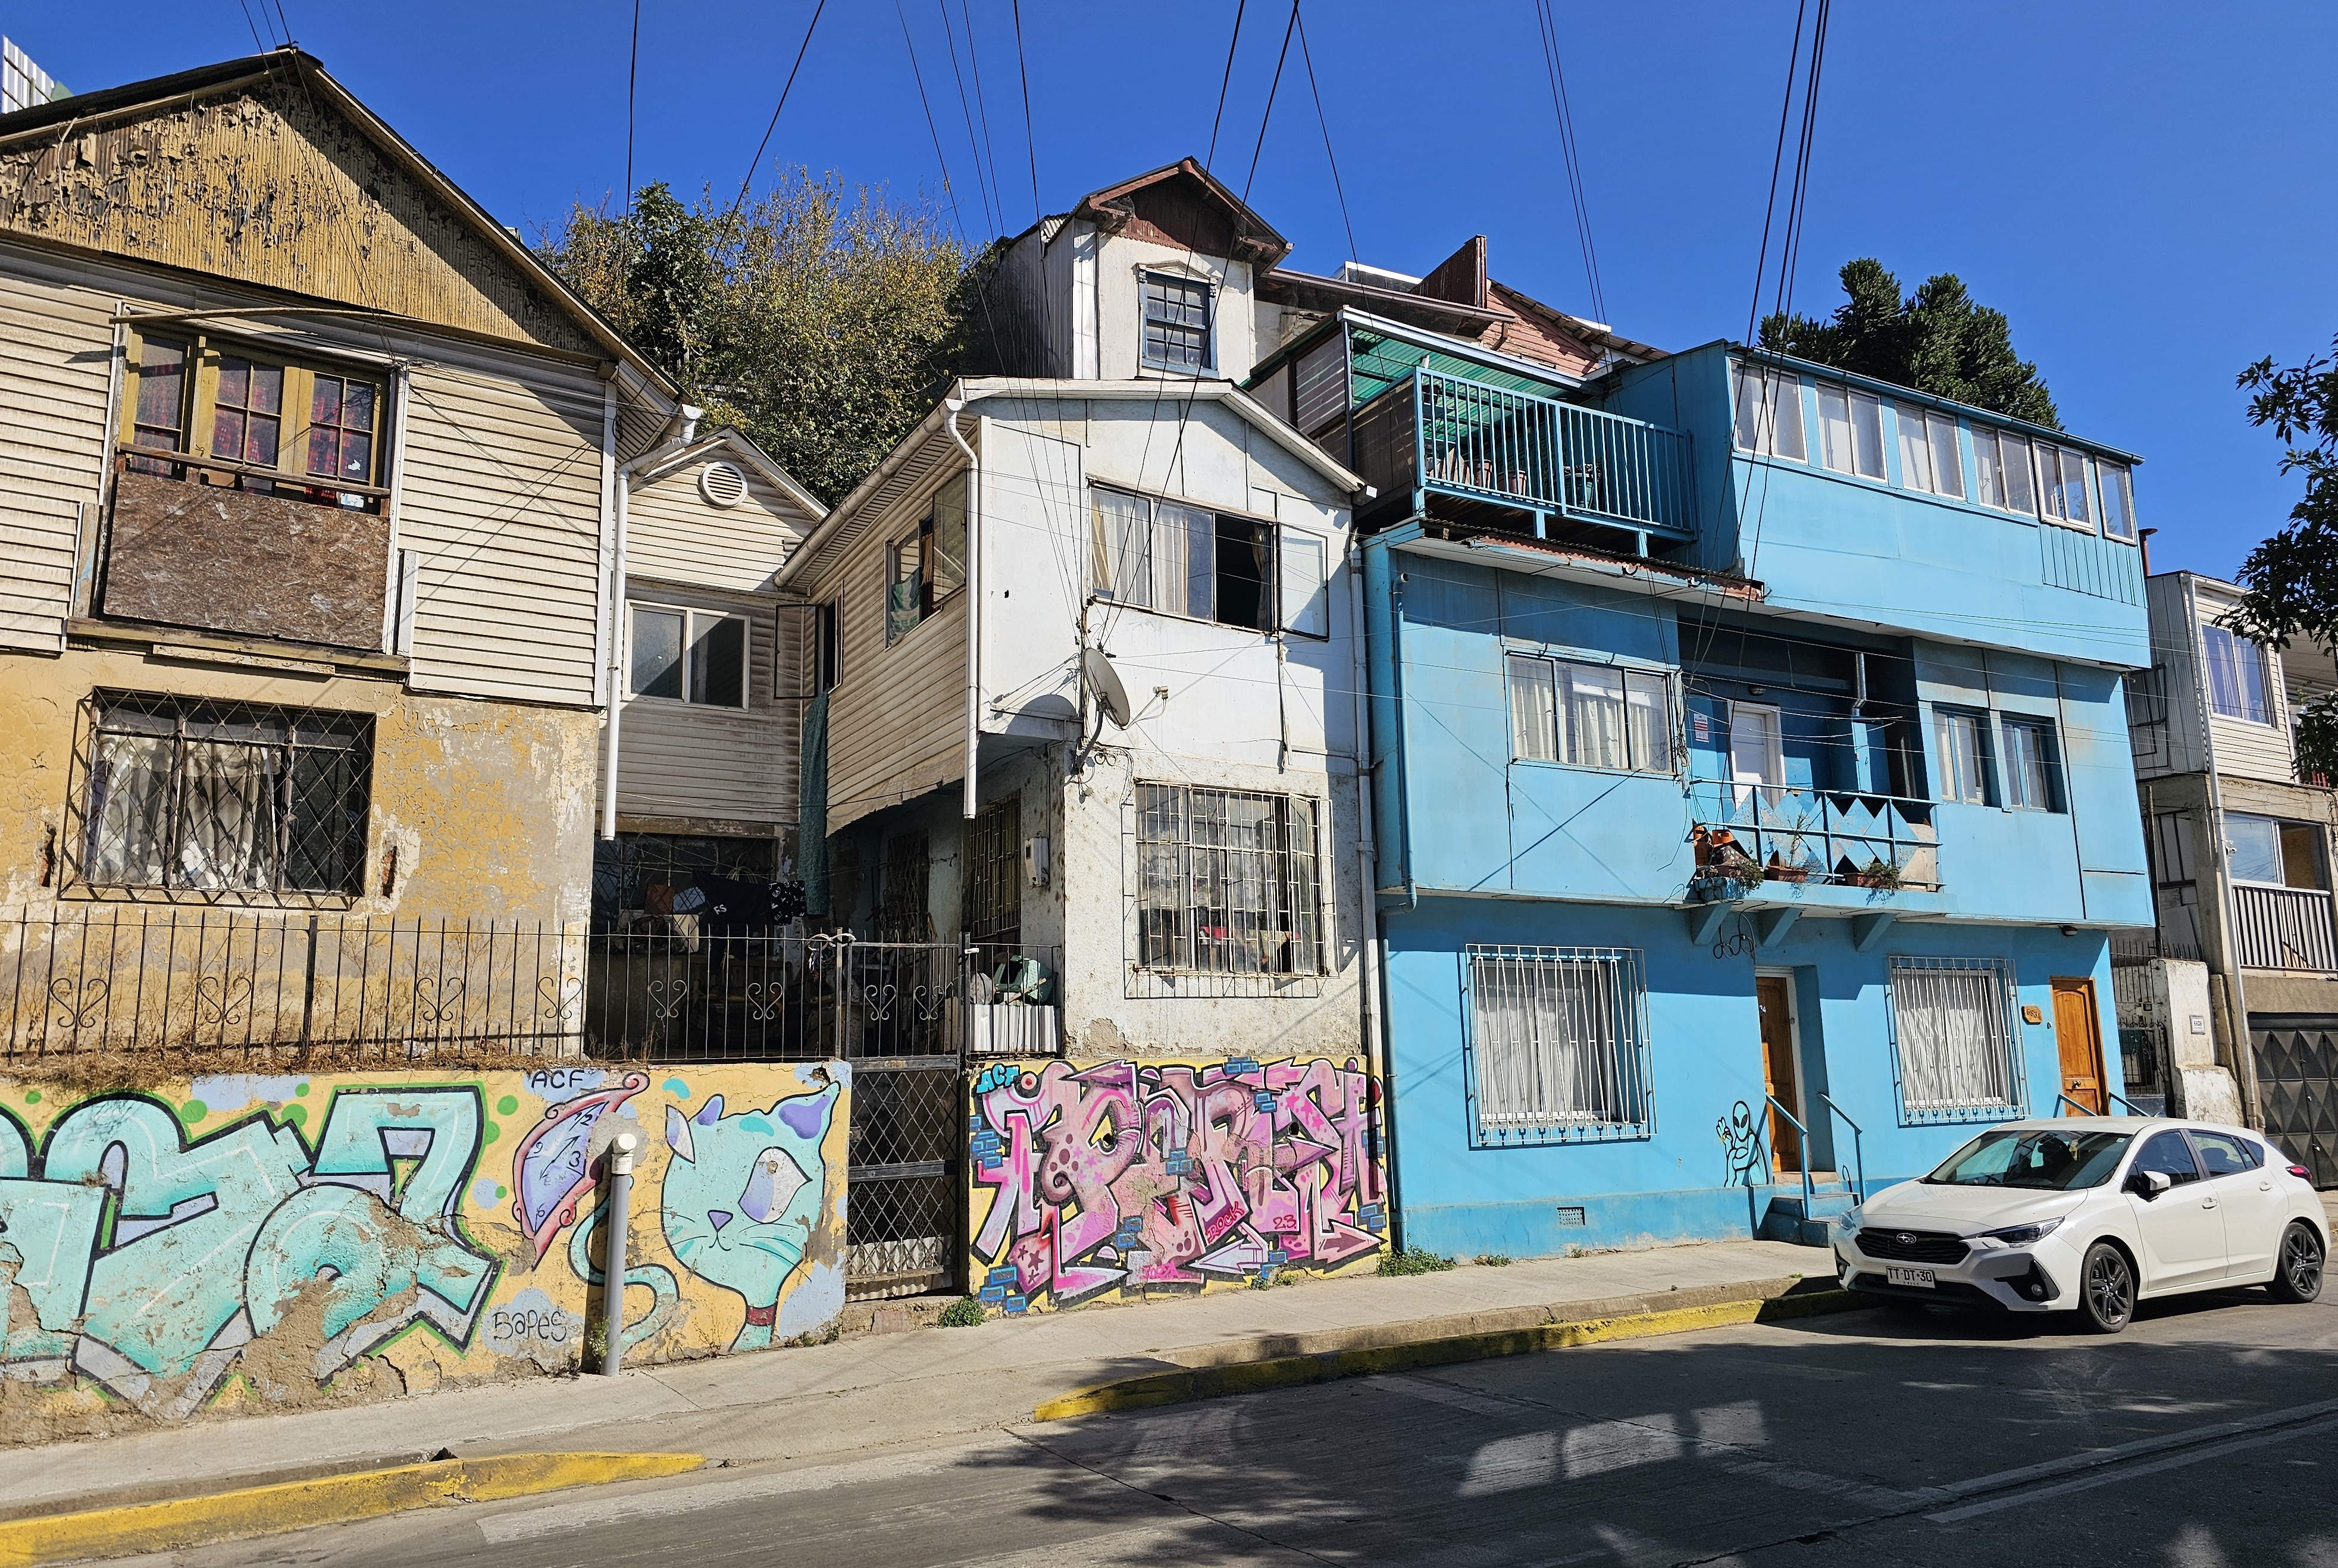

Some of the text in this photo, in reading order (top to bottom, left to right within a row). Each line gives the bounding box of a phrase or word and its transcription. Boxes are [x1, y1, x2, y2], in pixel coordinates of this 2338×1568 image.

[772, 887, 781, 897] EA7
[531, 1071, 584, 1088] ACF
[976, 1064, 1019, 1093] ACF
[569, 1150, 581, 1167] 3
[1206, 1201, 1244, 1243] ROCK
